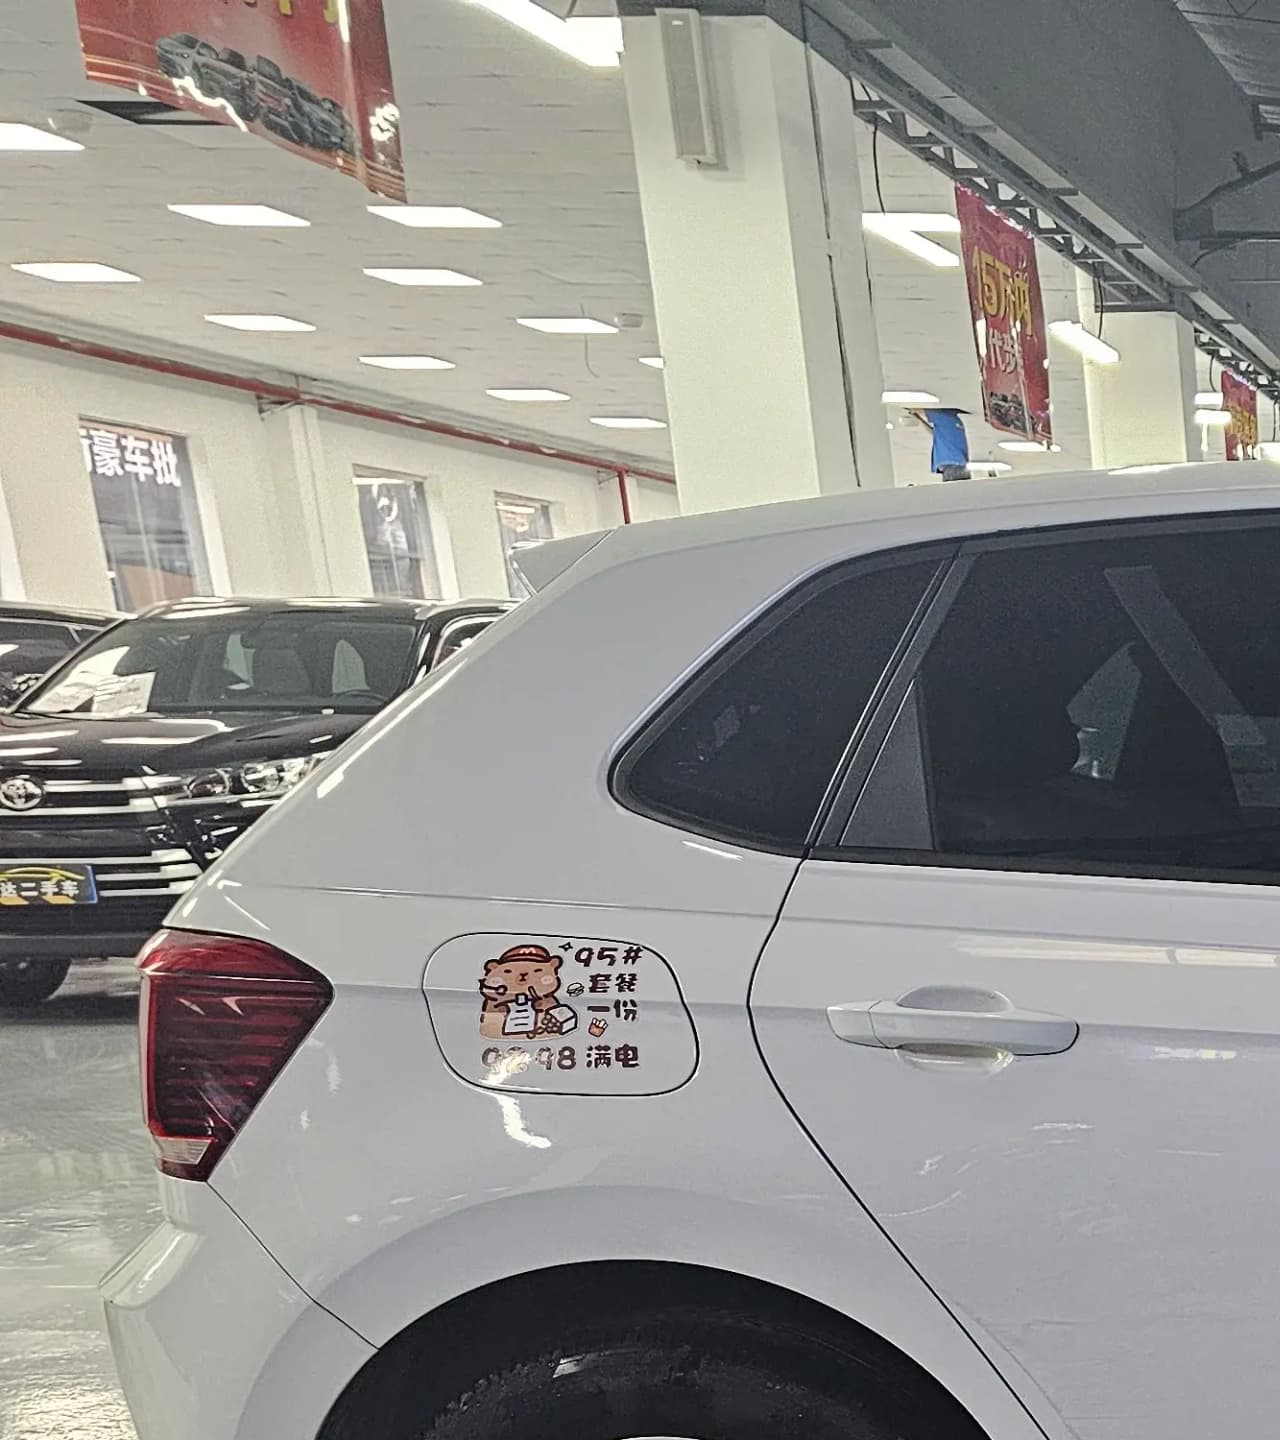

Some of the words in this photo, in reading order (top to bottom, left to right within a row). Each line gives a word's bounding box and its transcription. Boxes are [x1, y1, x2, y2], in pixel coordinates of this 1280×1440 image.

[574, 946, 643, 967] 95#
[588, 973, 638, 993] 套餐
[587, 999, 638, 1022] 一份
[586, 1044, 640, 1069] 满电
